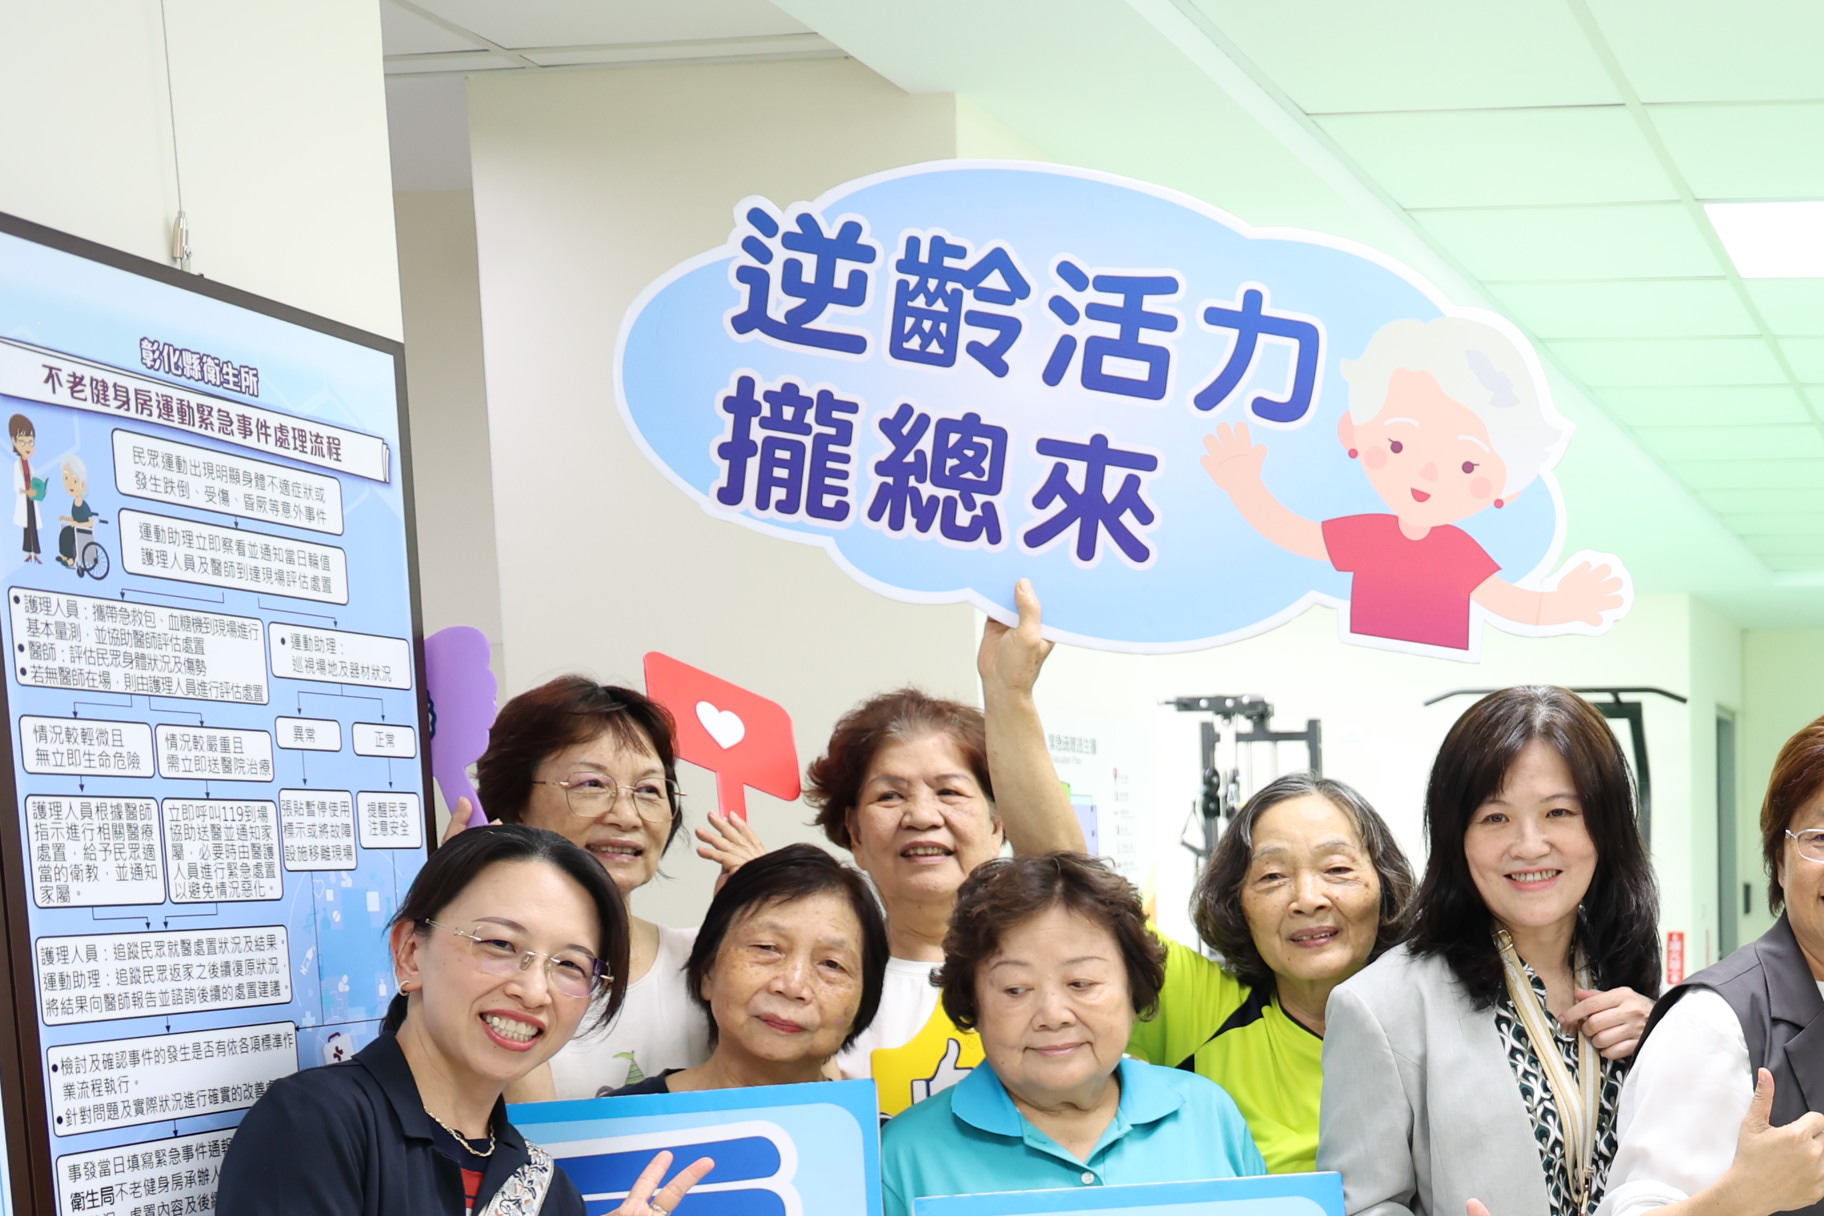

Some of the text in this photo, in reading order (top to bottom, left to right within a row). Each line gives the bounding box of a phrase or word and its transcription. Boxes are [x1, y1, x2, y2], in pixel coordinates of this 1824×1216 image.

[731, 207, 1321, 423] 逆齡活力
[138, 337, 259, 397] 彰化縣衛生所
[42, 364, 342, 462] 不老健身房運動緊急事件處理流程
[716, 376, 1160, 563] 攏總來
[33, 724, 125, 748] 情況較輕微且
[165, 733, 245, 754] 情況較嚴重且
[293, 725, 316, 743] 異常
[374, 731, 395, 748] 正常
[36, 748, 142, 770] 無立即生命危險
[166, 754, 271, 776] 需立即送醫院治療
[32, 801, 153, 821] 護理人員根據醫師
[169, 805, 269, 823] 立即呼叫119到場
[34, 822, 154, 842] 指示進行相關醫療
[169, 824, 273, 842] 協助送醫並通知家
[368, 821, 410, 837] 注意安全
[174, 862, 277, 880] 人員進行緊急處置
[65, 1080, 275, 1127] 針對問題及實際狀況進行確實的改善
